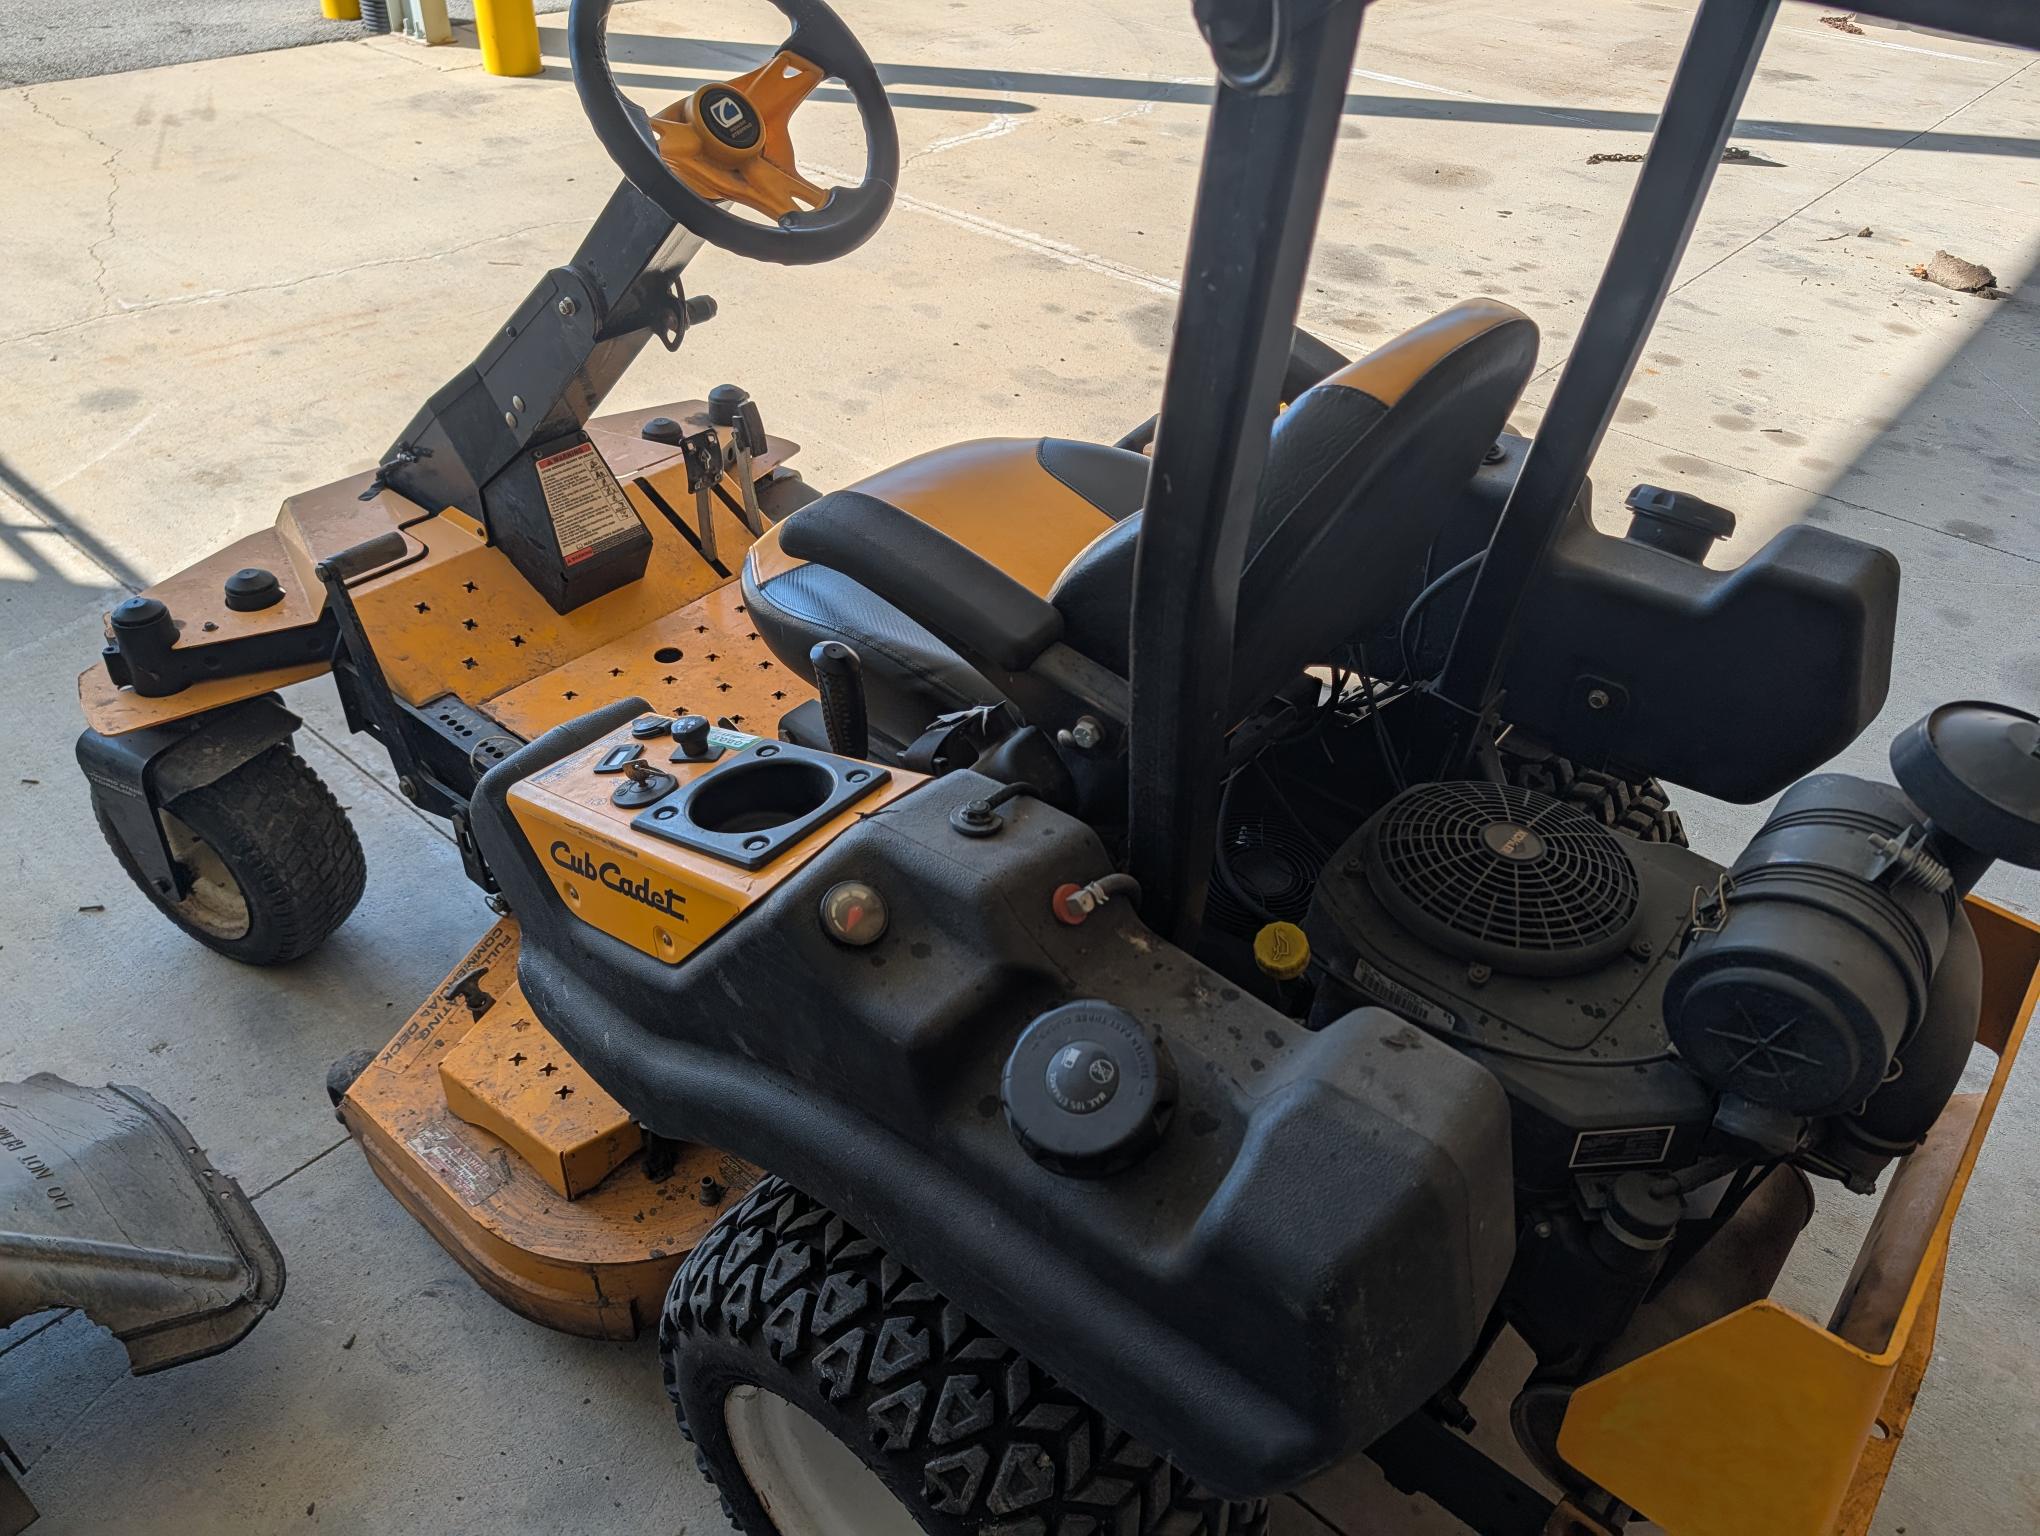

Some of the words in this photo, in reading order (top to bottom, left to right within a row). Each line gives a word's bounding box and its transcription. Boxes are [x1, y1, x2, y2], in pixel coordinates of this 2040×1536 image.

[553, 447, 584, 463] WARNING
[550, 841, 597, 881] Cub
[599, 862, 686, 921] Cadet
[483, 934, 512, 965] FULL
[381, 1022, 420, 1065] DECK
[17, 1154, 55, 1180] NOT
[46, 1186, 75, 1210] DO
